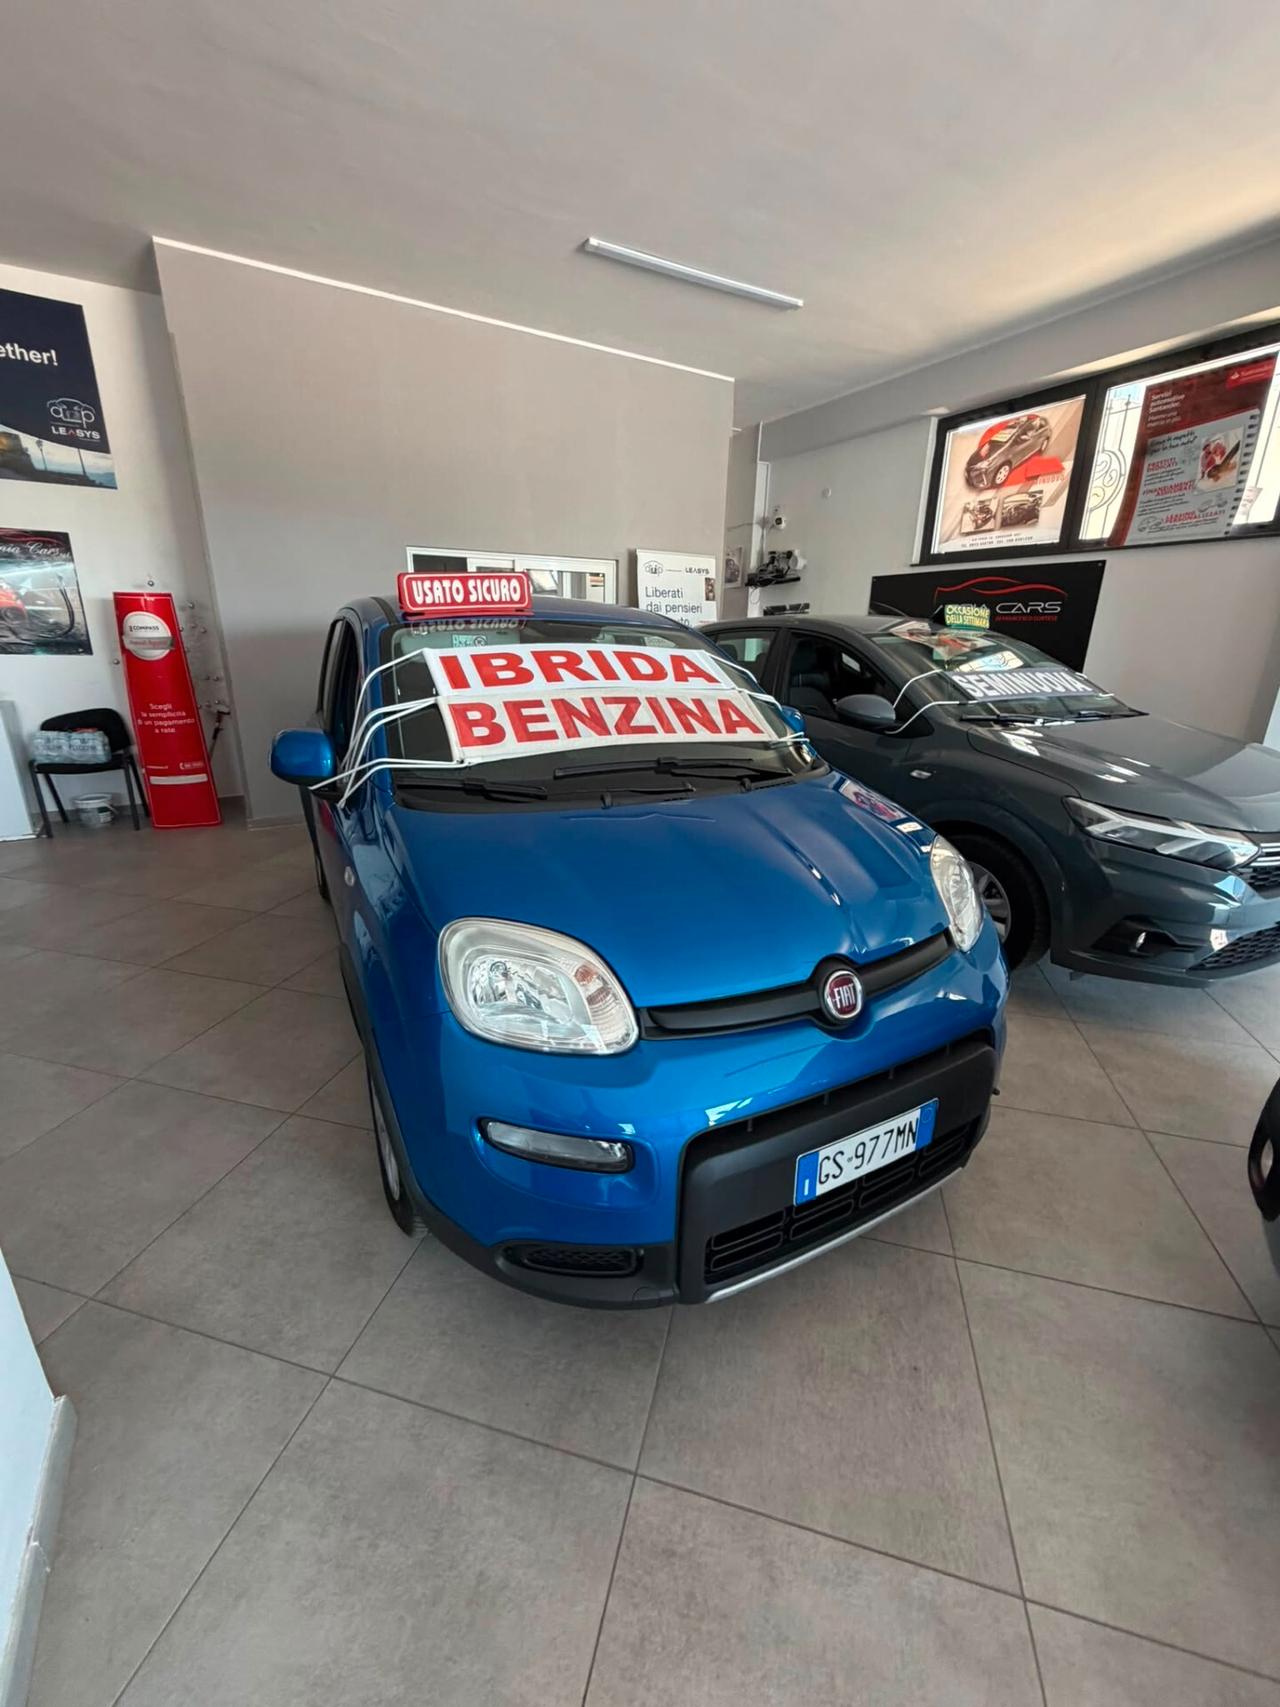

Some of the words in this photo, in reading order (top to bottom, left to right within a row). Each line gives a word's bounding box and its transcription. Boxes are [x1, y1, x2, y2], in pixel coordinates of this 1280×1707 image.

[51, 426, 101, 439] LEASYS
[685, 567, 710, 575] LEASYS
[412, 579, 464, 605] USATO
[468, 578, 521, 603] SICURO
[645, 586, 684, 598] Liberati
[646, 601, 662, 613] dai
[665, 603, 703, 615] pensieri
[945, 604, 990, 618] OCCASIONE
[995, 601, 1063, 614] CARS
[945, 614, 963, 626] DELLA
[439, 650, 722, 690] IBRIDA
[951, 672, 1093, 698] SEMINUOVA
[154, 718, 195, 727] pagamento
[448, 696, 765, 748] BENZINA
[833, 982, 856, 1009] FIAT
